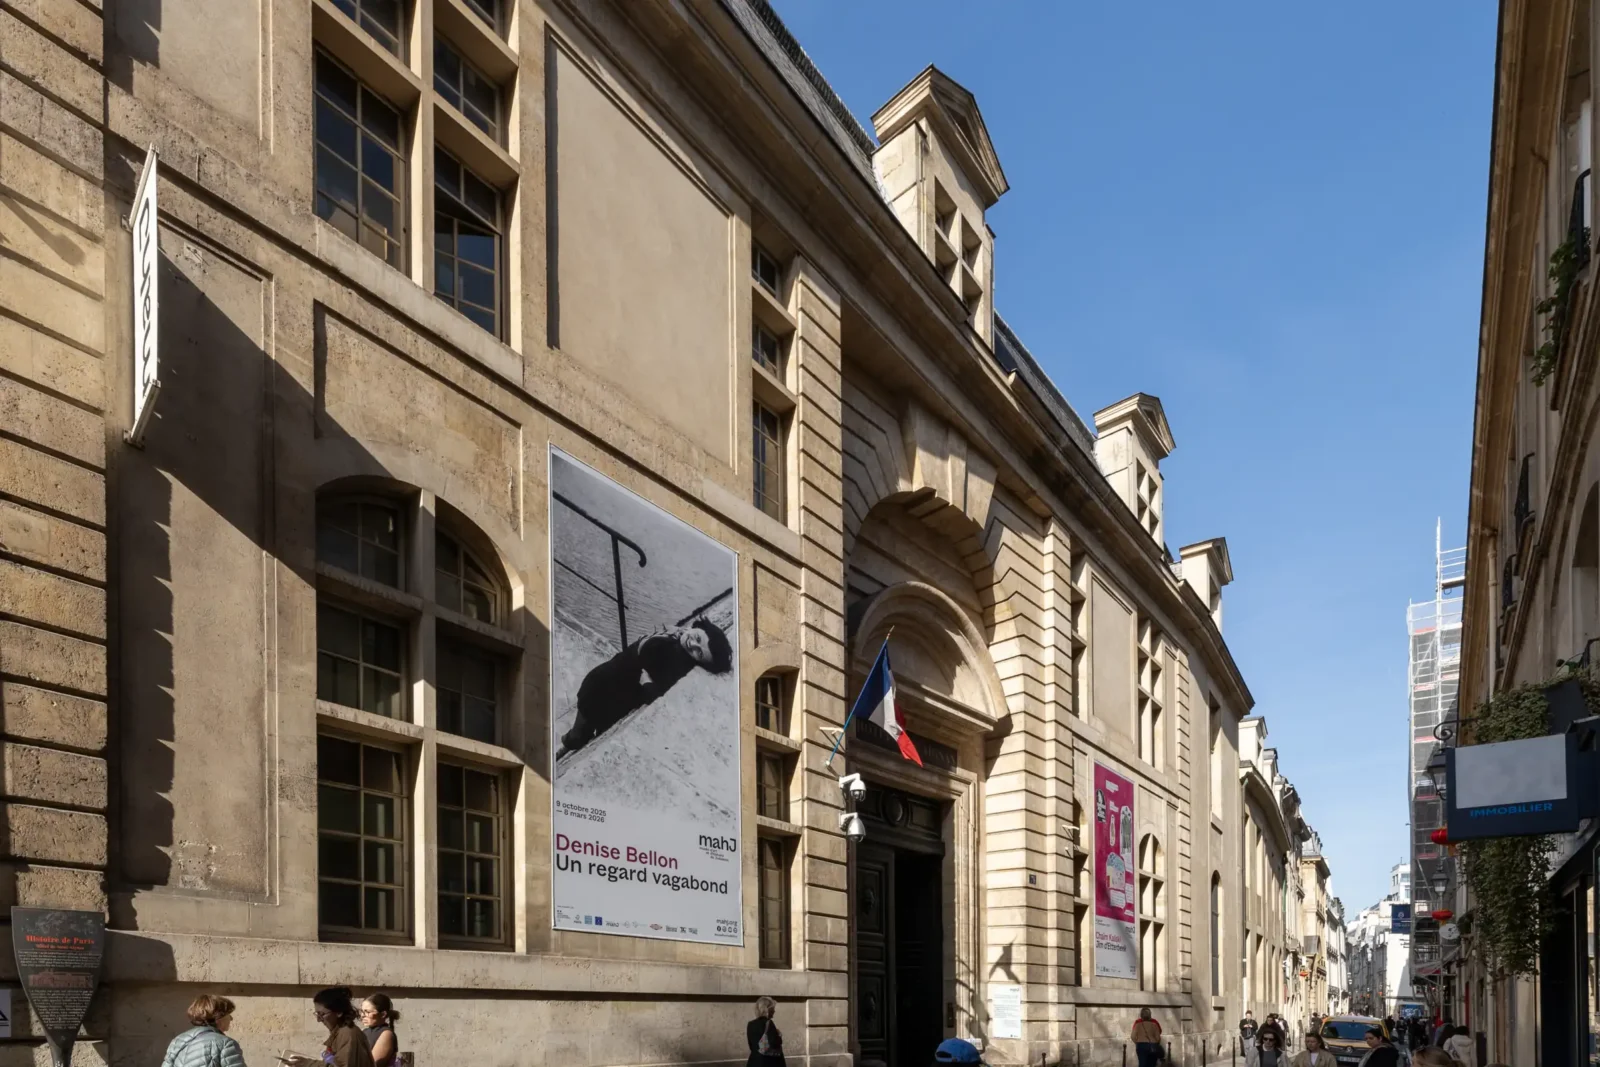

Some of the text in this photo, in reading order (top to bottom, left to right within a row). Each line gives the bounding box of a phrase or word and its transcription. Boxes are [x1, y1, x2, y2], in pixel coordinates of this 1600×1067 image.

[562, 802, 589, 813] octobre
[590, 807, 607, 817] 2025
[570, 811, 587, 820] mars
[588, 814, 605, 823] 2026
[1470, 802, 1553, 818] IMMOBILIER
[699, 834, 737, 852] mahJ
[556, 833, 679, 870] Denise Bellon
[556, 853, 728, 895] Un regard vagabond
[25, 934, 95, 945] Histoire de Paris
